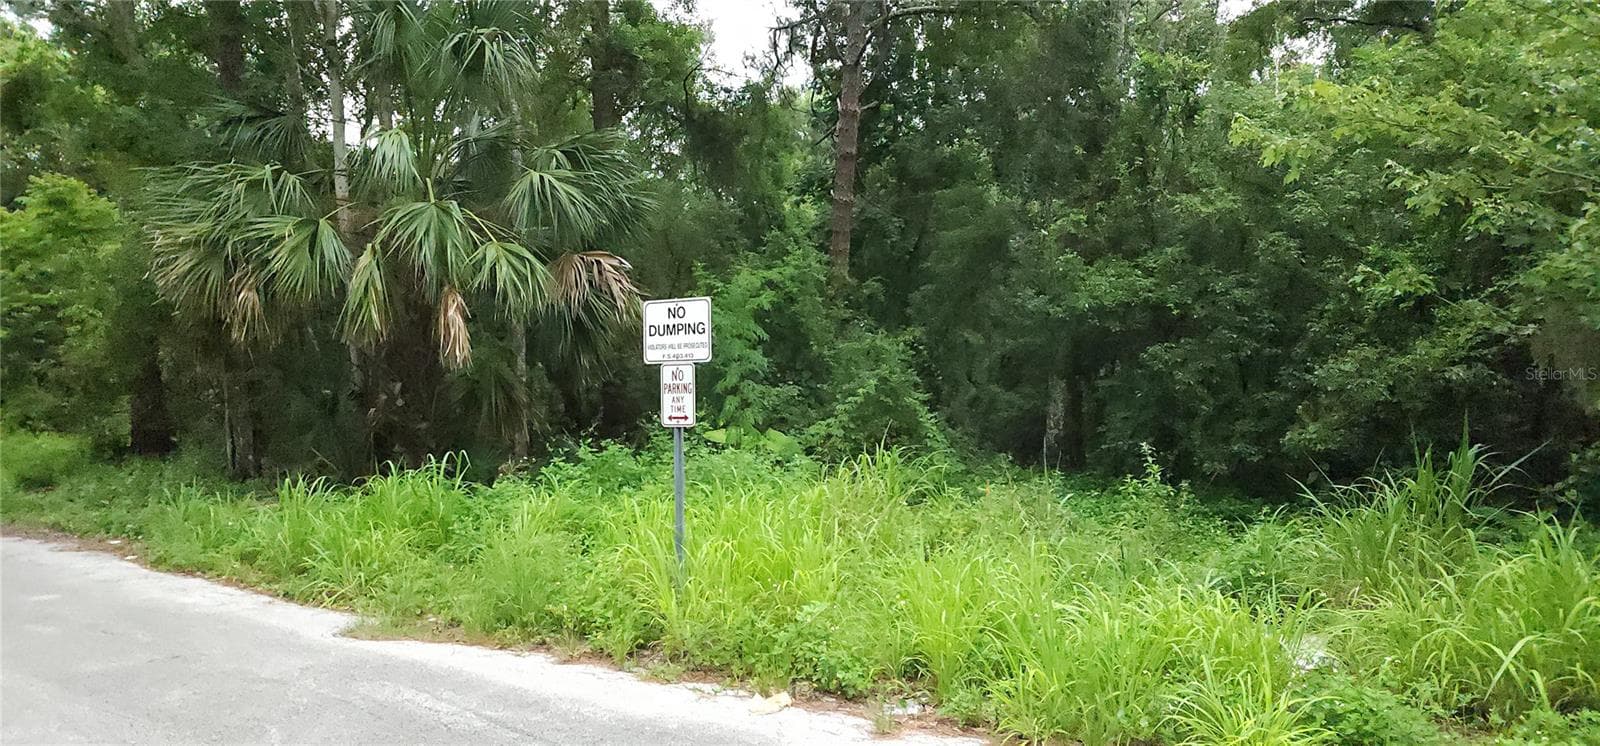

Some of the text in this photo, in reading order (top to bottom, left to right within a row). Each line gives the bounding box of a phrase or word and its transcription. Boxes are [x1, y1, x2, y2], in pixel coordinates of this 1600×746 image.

[667, 306, 686, 319] NO
[648, 322, 706, 337] DUMPING
[671, 369, 684, 381] NO
[663, 383, 692, 394] PARKING
[671, 396, 684, 404] ANY
[670, 405, 686, 413] TIME
